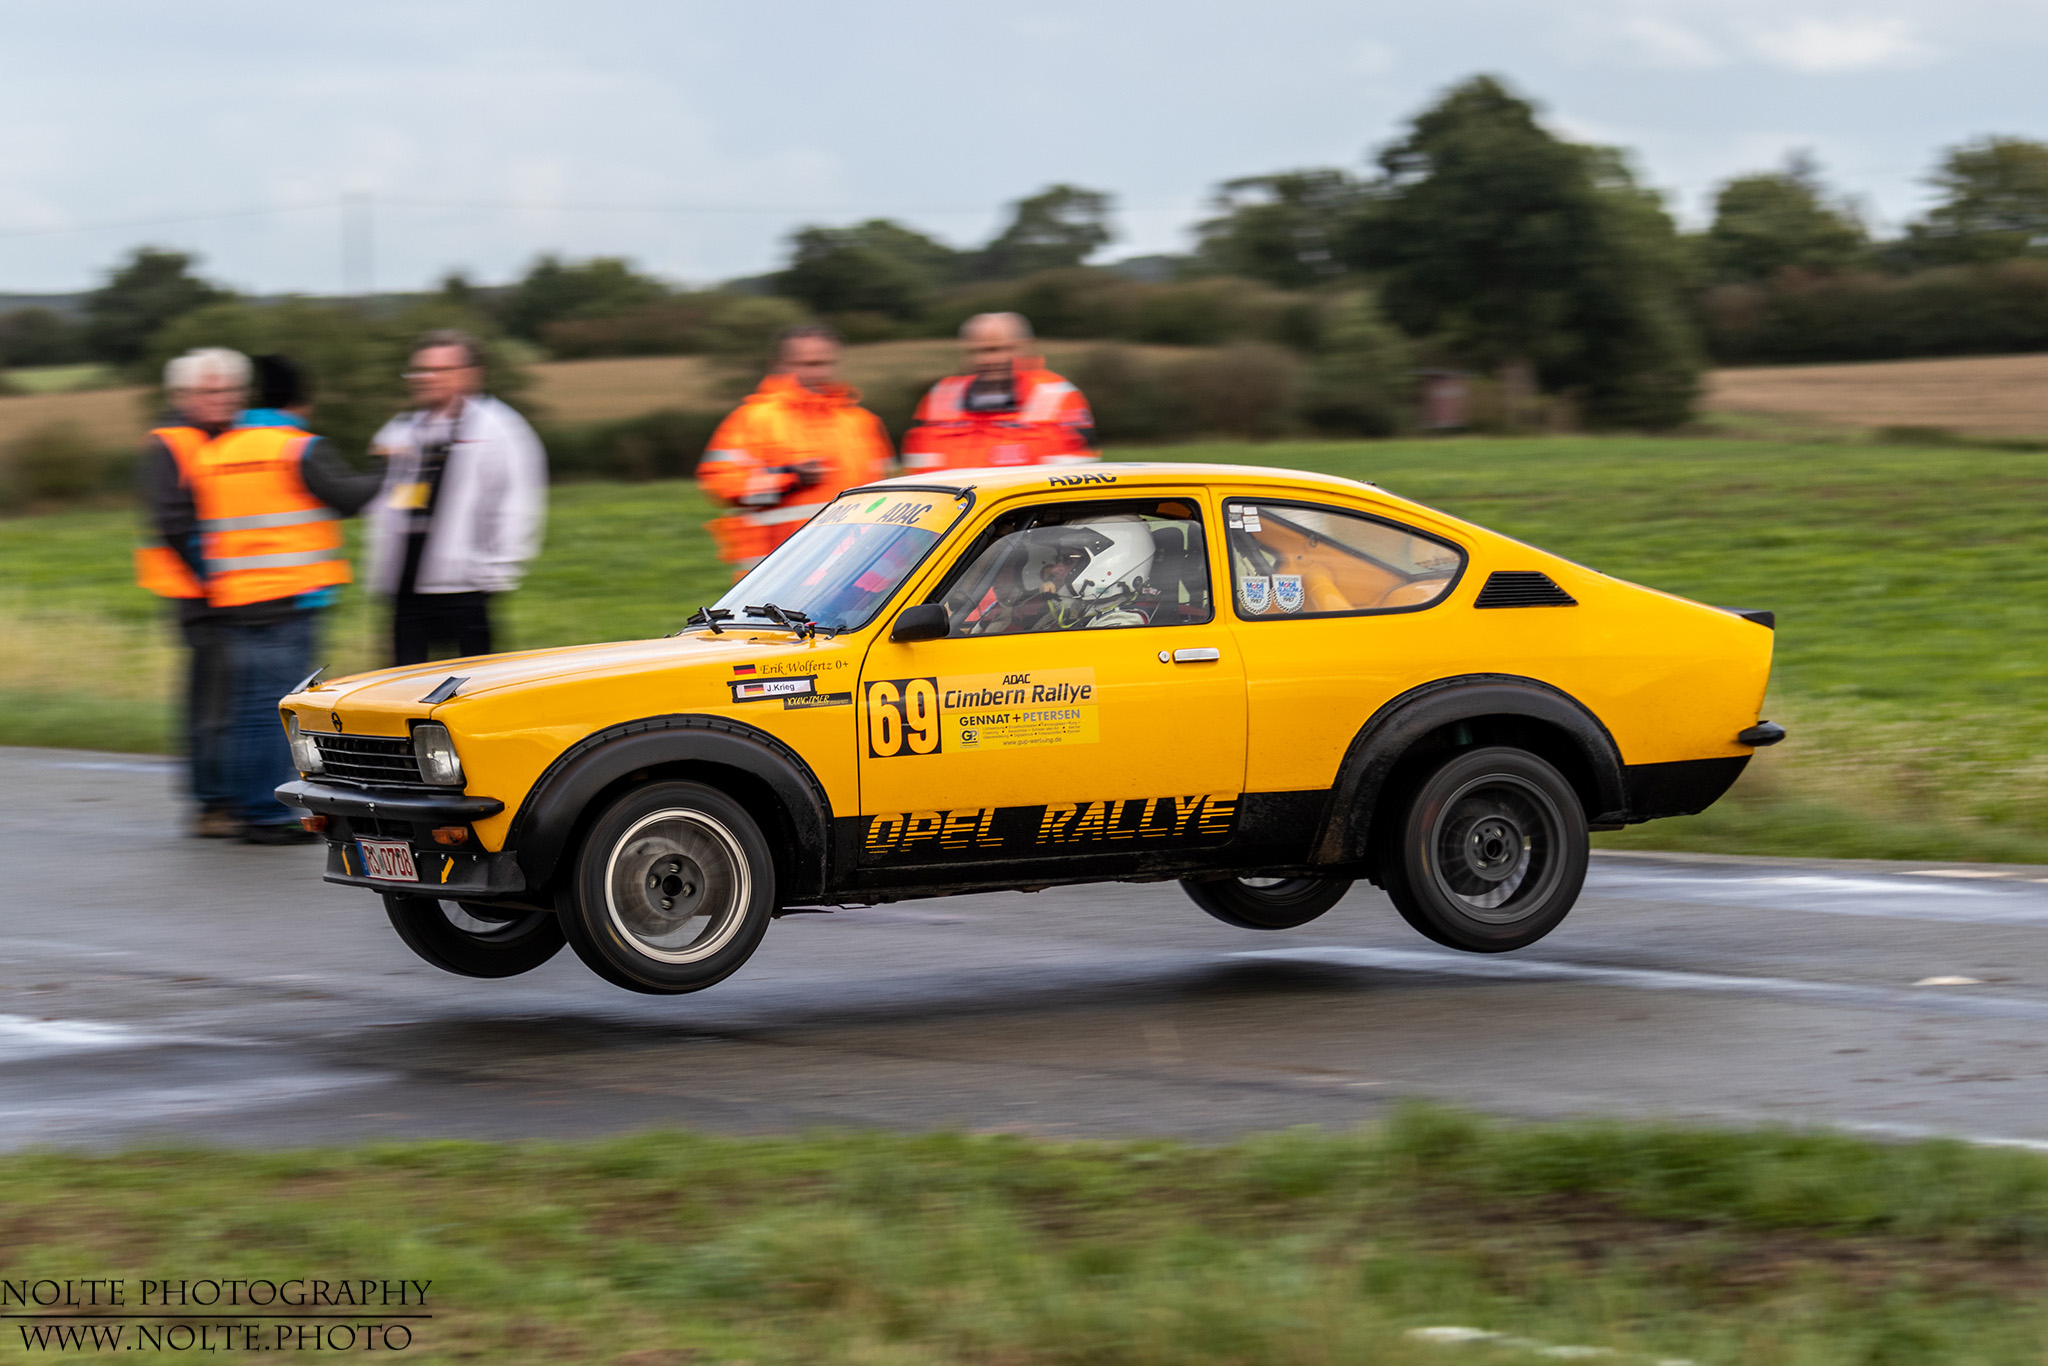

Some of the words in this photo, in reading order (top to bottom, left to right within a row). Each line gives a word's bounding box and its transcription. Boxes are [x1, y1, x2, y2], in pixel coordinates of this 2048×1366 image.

[1048, 472, 1117, 487] ADAC
[876, 502, 932, 525] ADAC
[760, 662, 786, 675] Erik
[787, 660, 832, 675] Wolfertz
[1002, 673, 1031, 686] ADAC
[944, 688, 1025, 709] Cimbern
[1031, 683, 1092, 704] Rallye
[868, 678, 939, 757] 69
[865, 808, 1005, 855] OPEL
[1035, 792, 1240, 845] RALLYE
